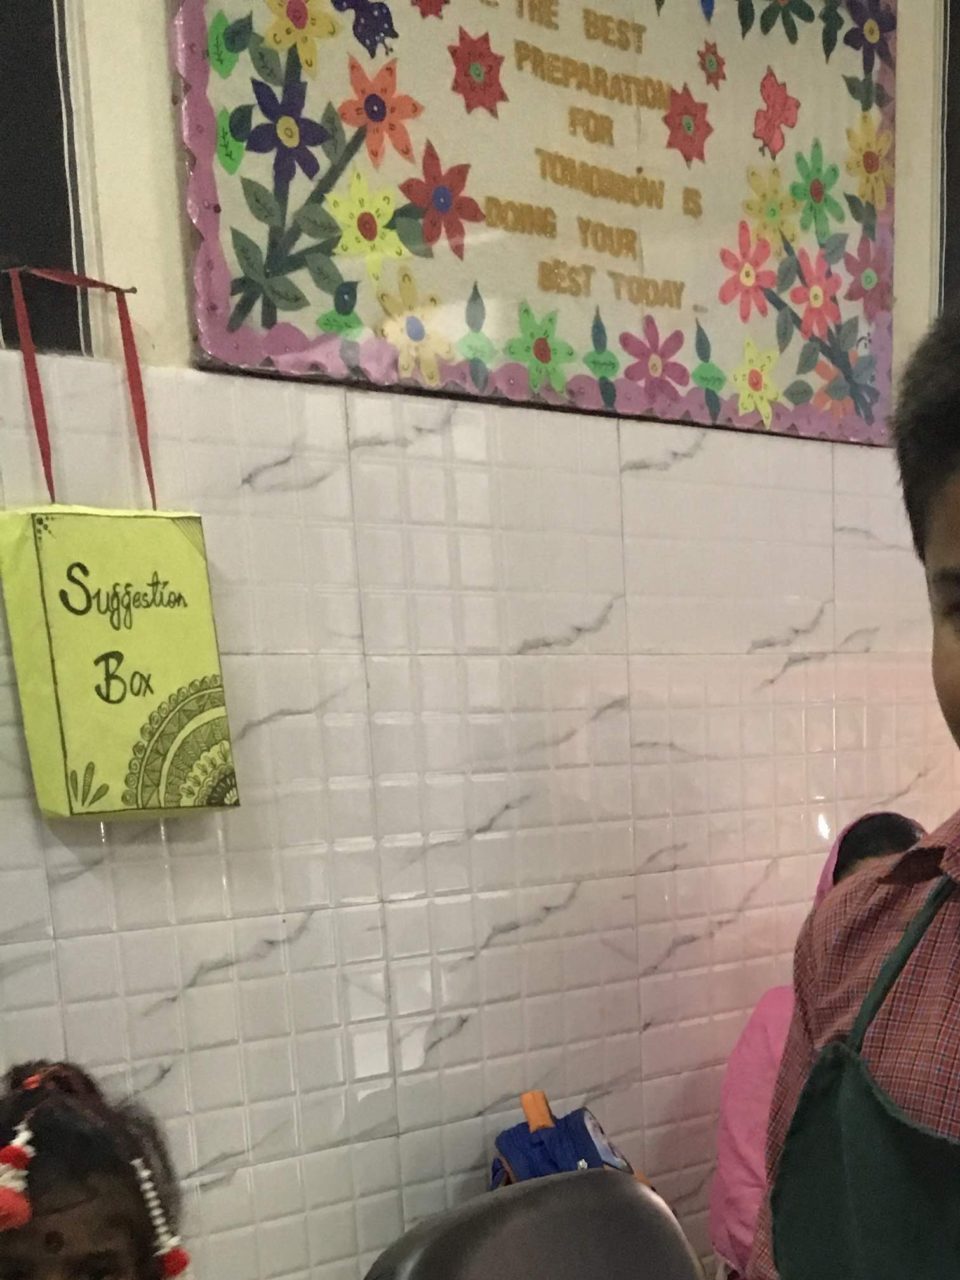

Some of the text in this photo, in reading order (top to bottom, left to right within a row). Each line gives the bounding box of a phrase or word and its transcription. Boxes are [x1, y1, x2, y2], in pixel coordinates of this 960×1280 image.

[583, 8, 647, 54] BEST
[514, 38, 670, 111] PREPARATION
[568, 105, 615, 146] FOR
[534, 147, 665, 210] TOMORROW
[485, 196, 637, 261] DOING YOUR
[537, 258, 685, 310] BEST TODAY
[59, 562, 188, 631] Suggestion
[93, 650, 155, 704] Box
